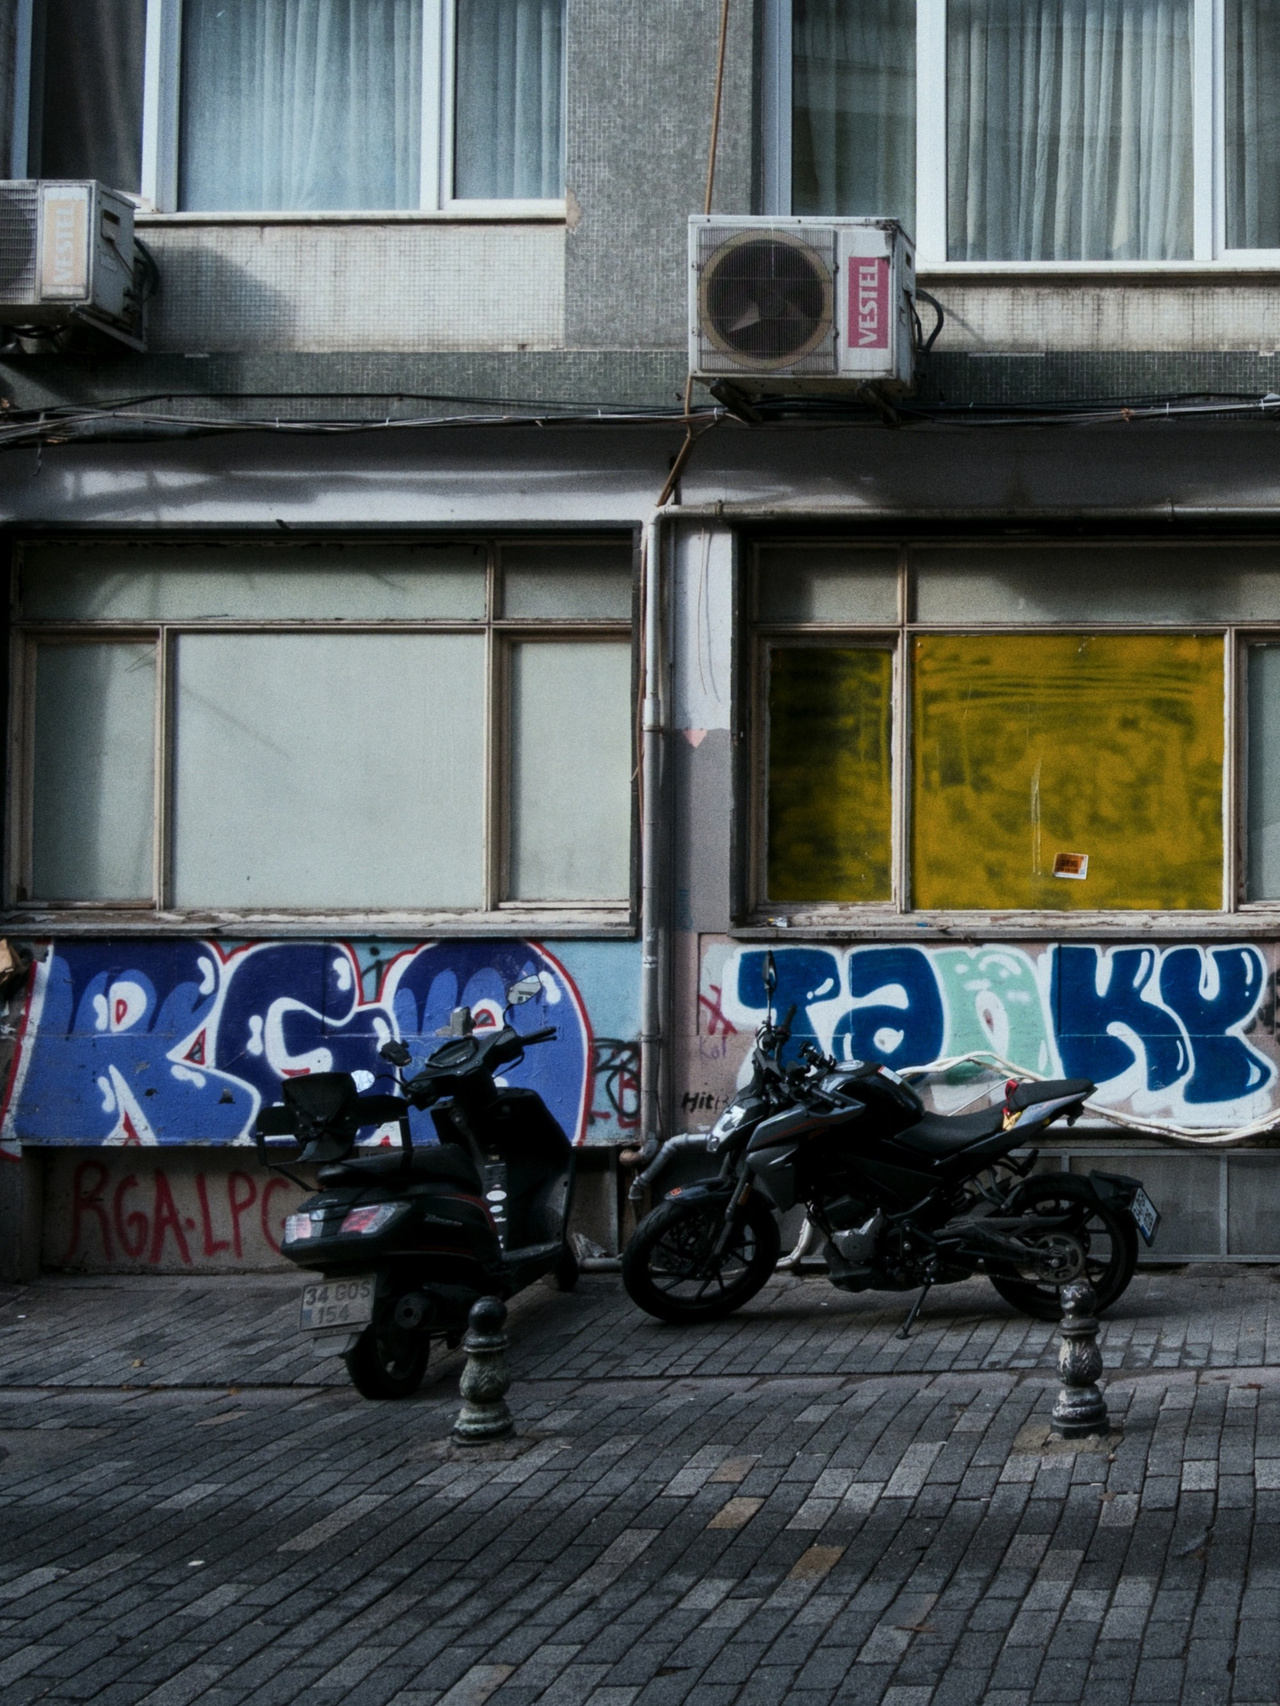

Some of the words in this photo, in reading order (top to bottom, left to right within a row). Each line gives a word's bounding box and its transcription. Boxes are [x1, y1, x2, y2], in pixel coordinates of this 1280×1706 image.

[53, 204, 76, 283] VESTEL
[857, 258, 879, 347] VESTEL
[318, 1303, 350, 1324] 154
